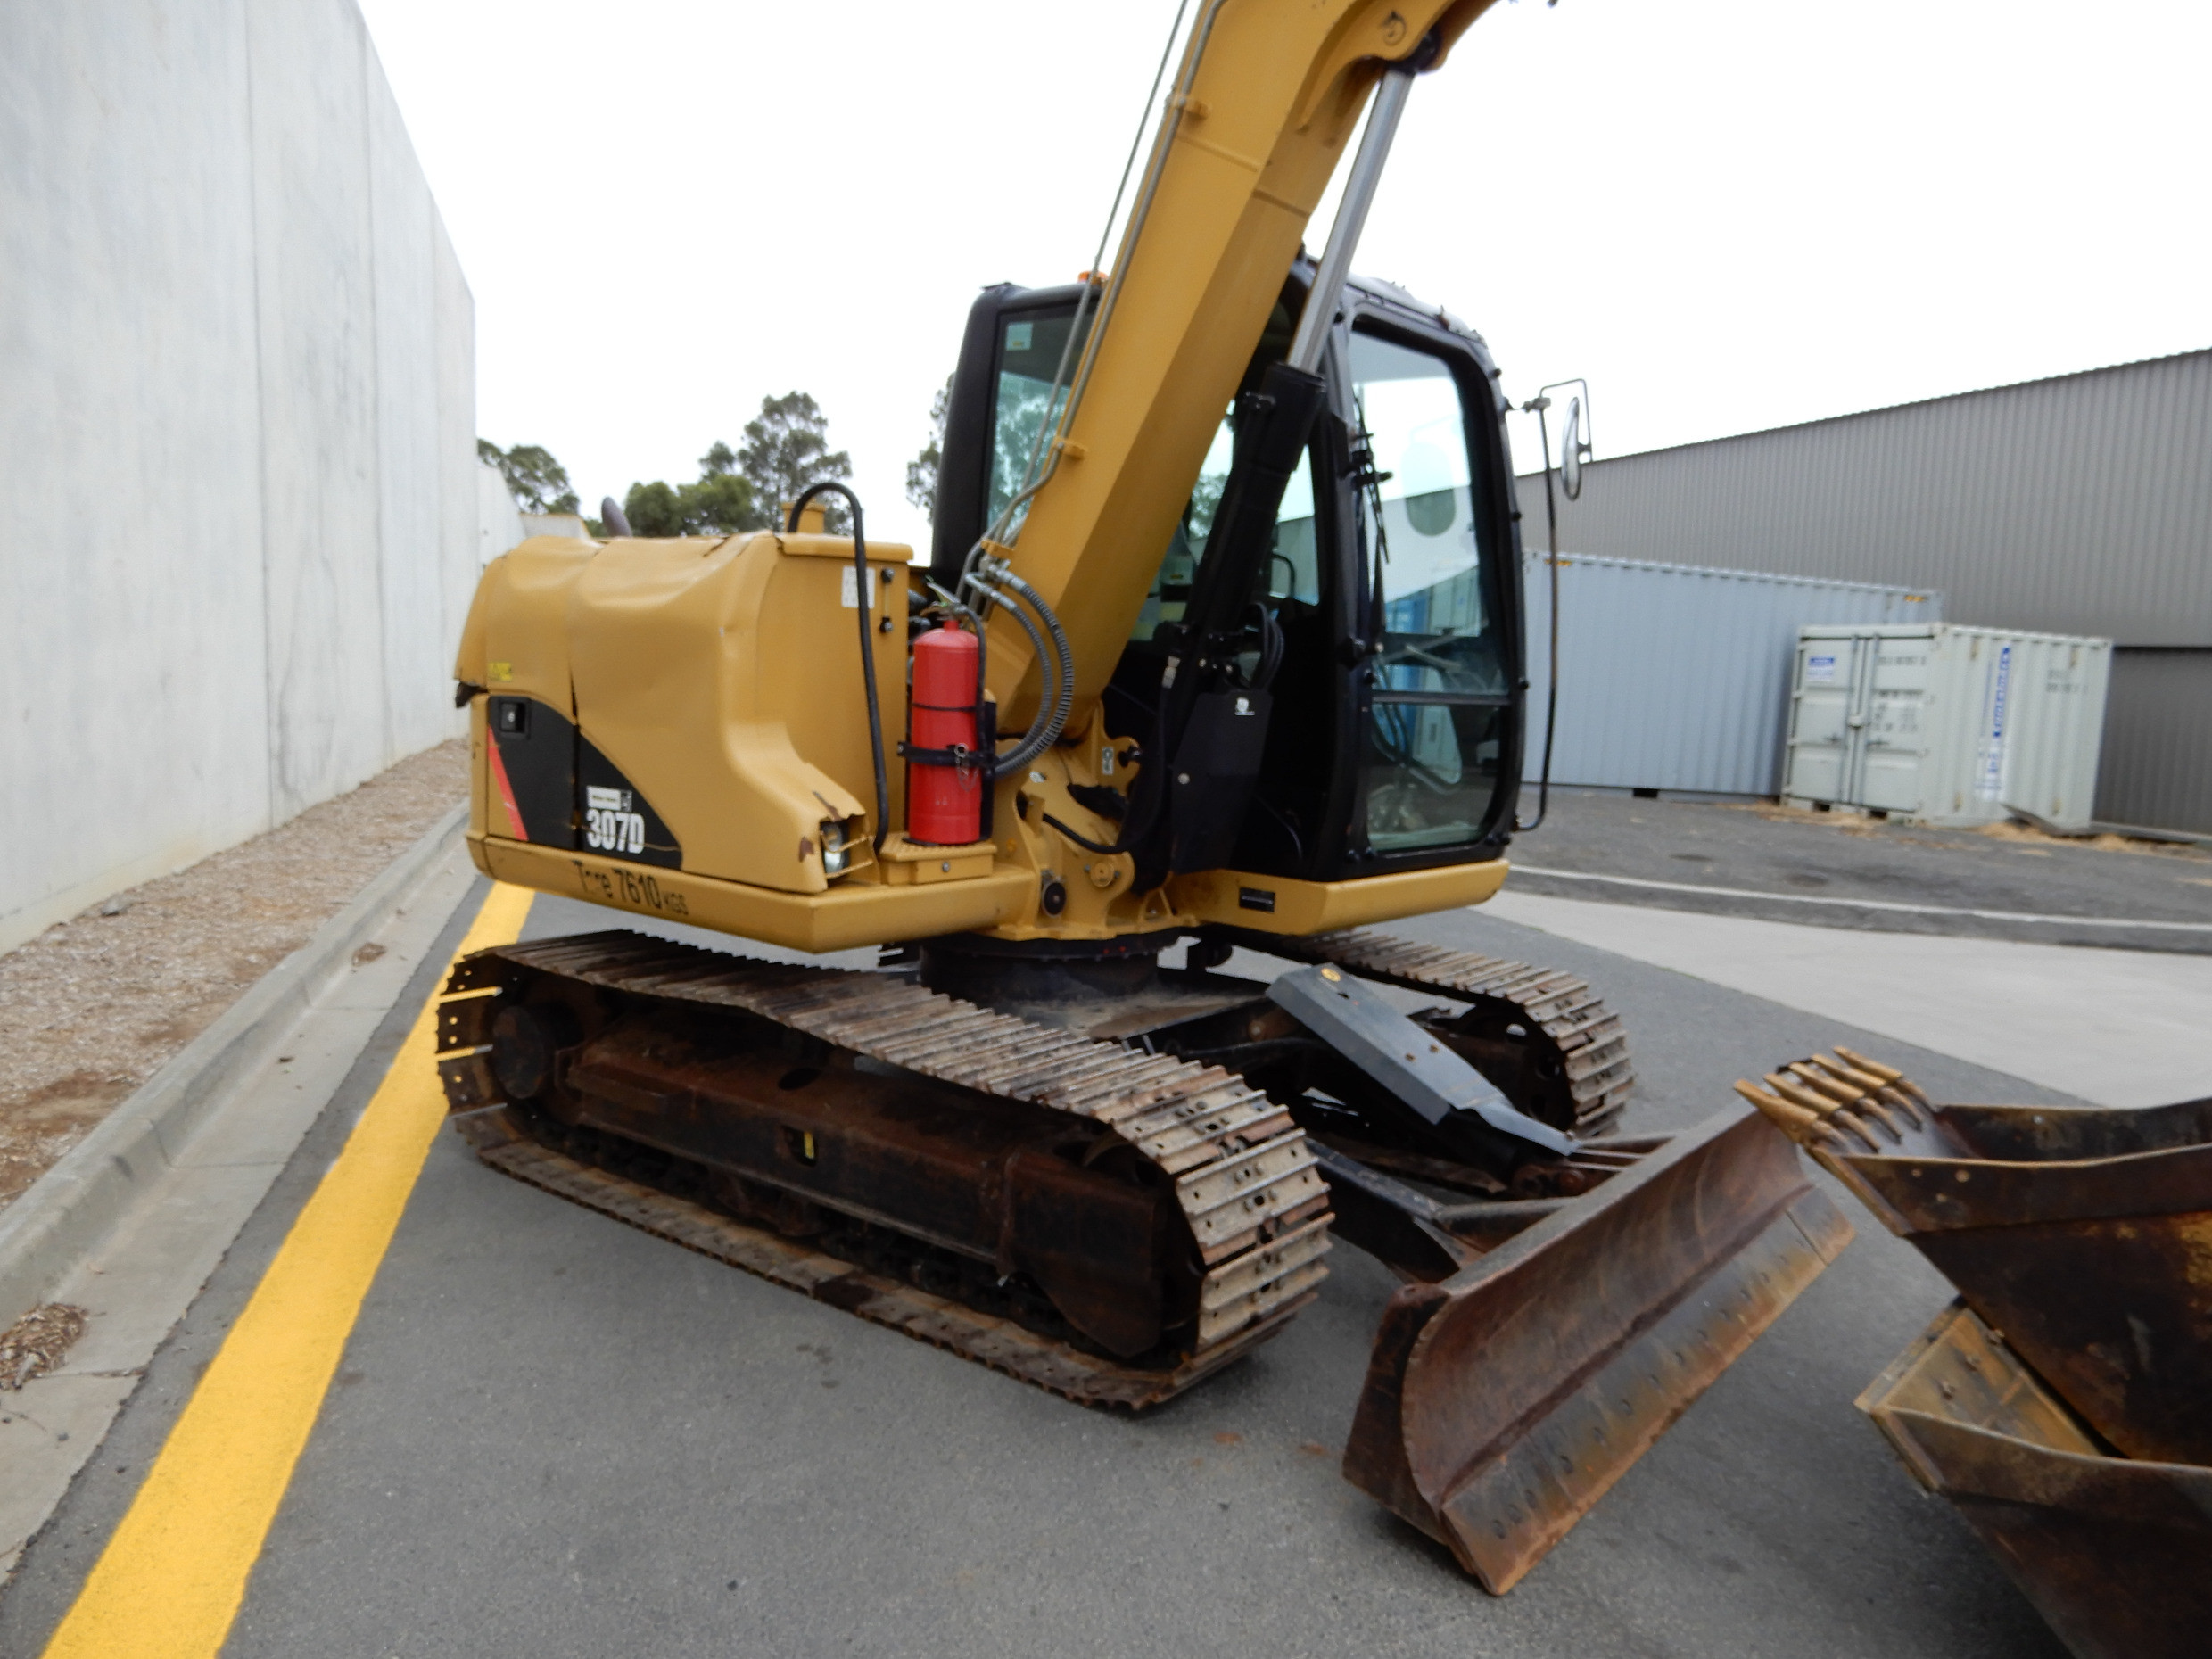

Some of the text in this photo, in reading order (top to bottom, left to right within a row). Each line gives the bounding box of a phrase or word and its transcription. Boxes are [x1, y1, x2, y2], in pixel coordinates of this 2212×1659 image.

[586, 808, 645, 854] 307D
[572, 859, 613, 899] Te
[613, 868, 662, 909] 7610
